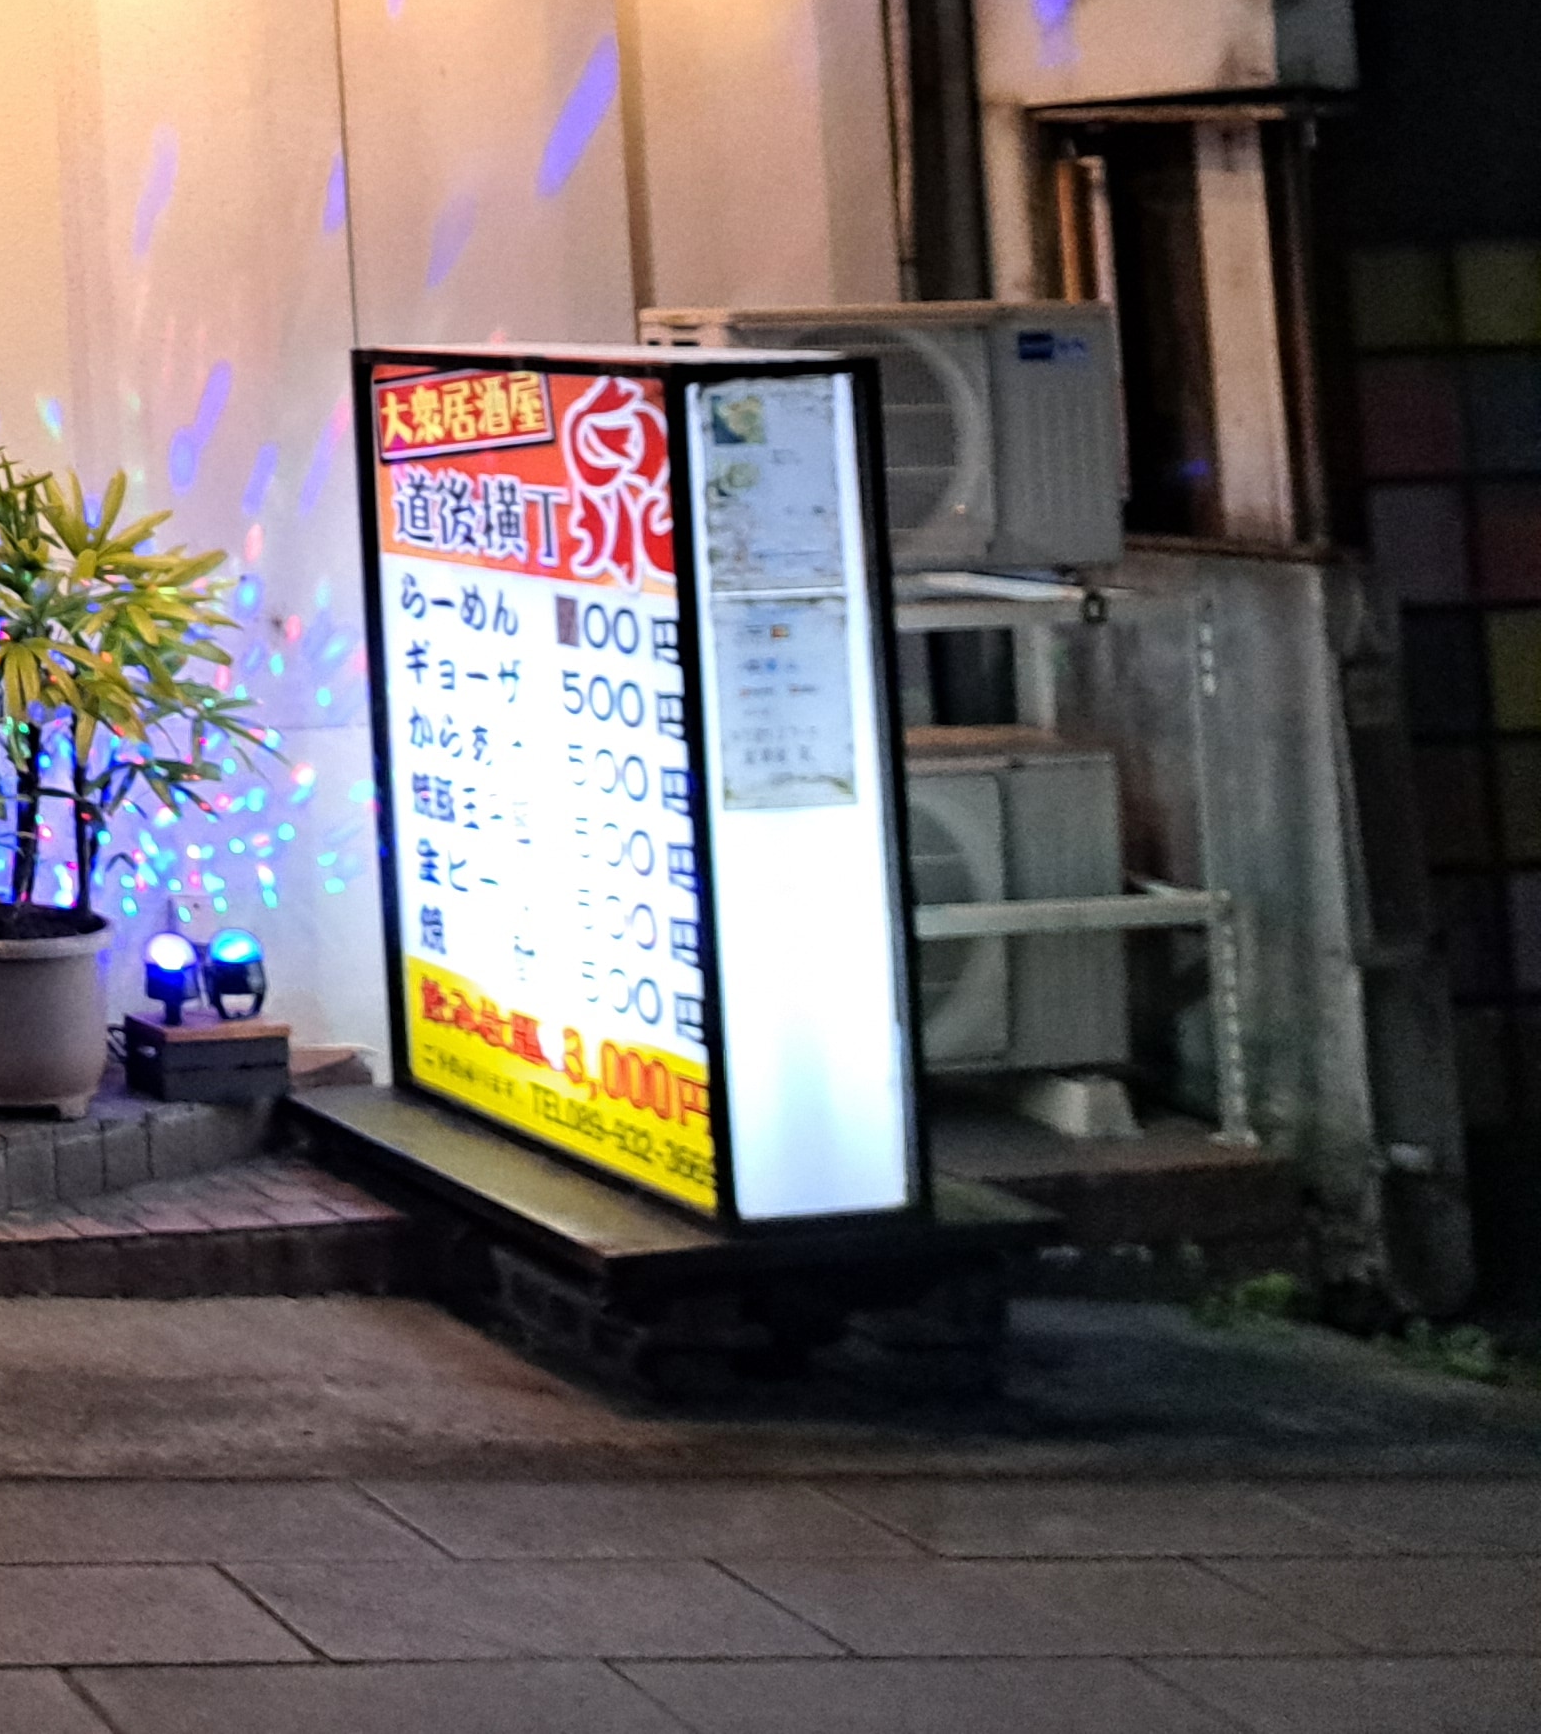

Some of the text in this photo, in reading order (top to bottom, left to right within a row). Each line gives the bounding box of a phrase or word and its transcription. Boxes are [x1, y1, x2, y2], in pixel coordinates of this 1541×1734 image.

[381, 370, 546, 448] 大衆居酒屋
[394, 469, 569, 564] 道後横丁
[401, 572, 680, 666] らーめん 00円
[406, 639, 685, 740] ギョーザ 500円
[408, 707, 522, 766] からあ
